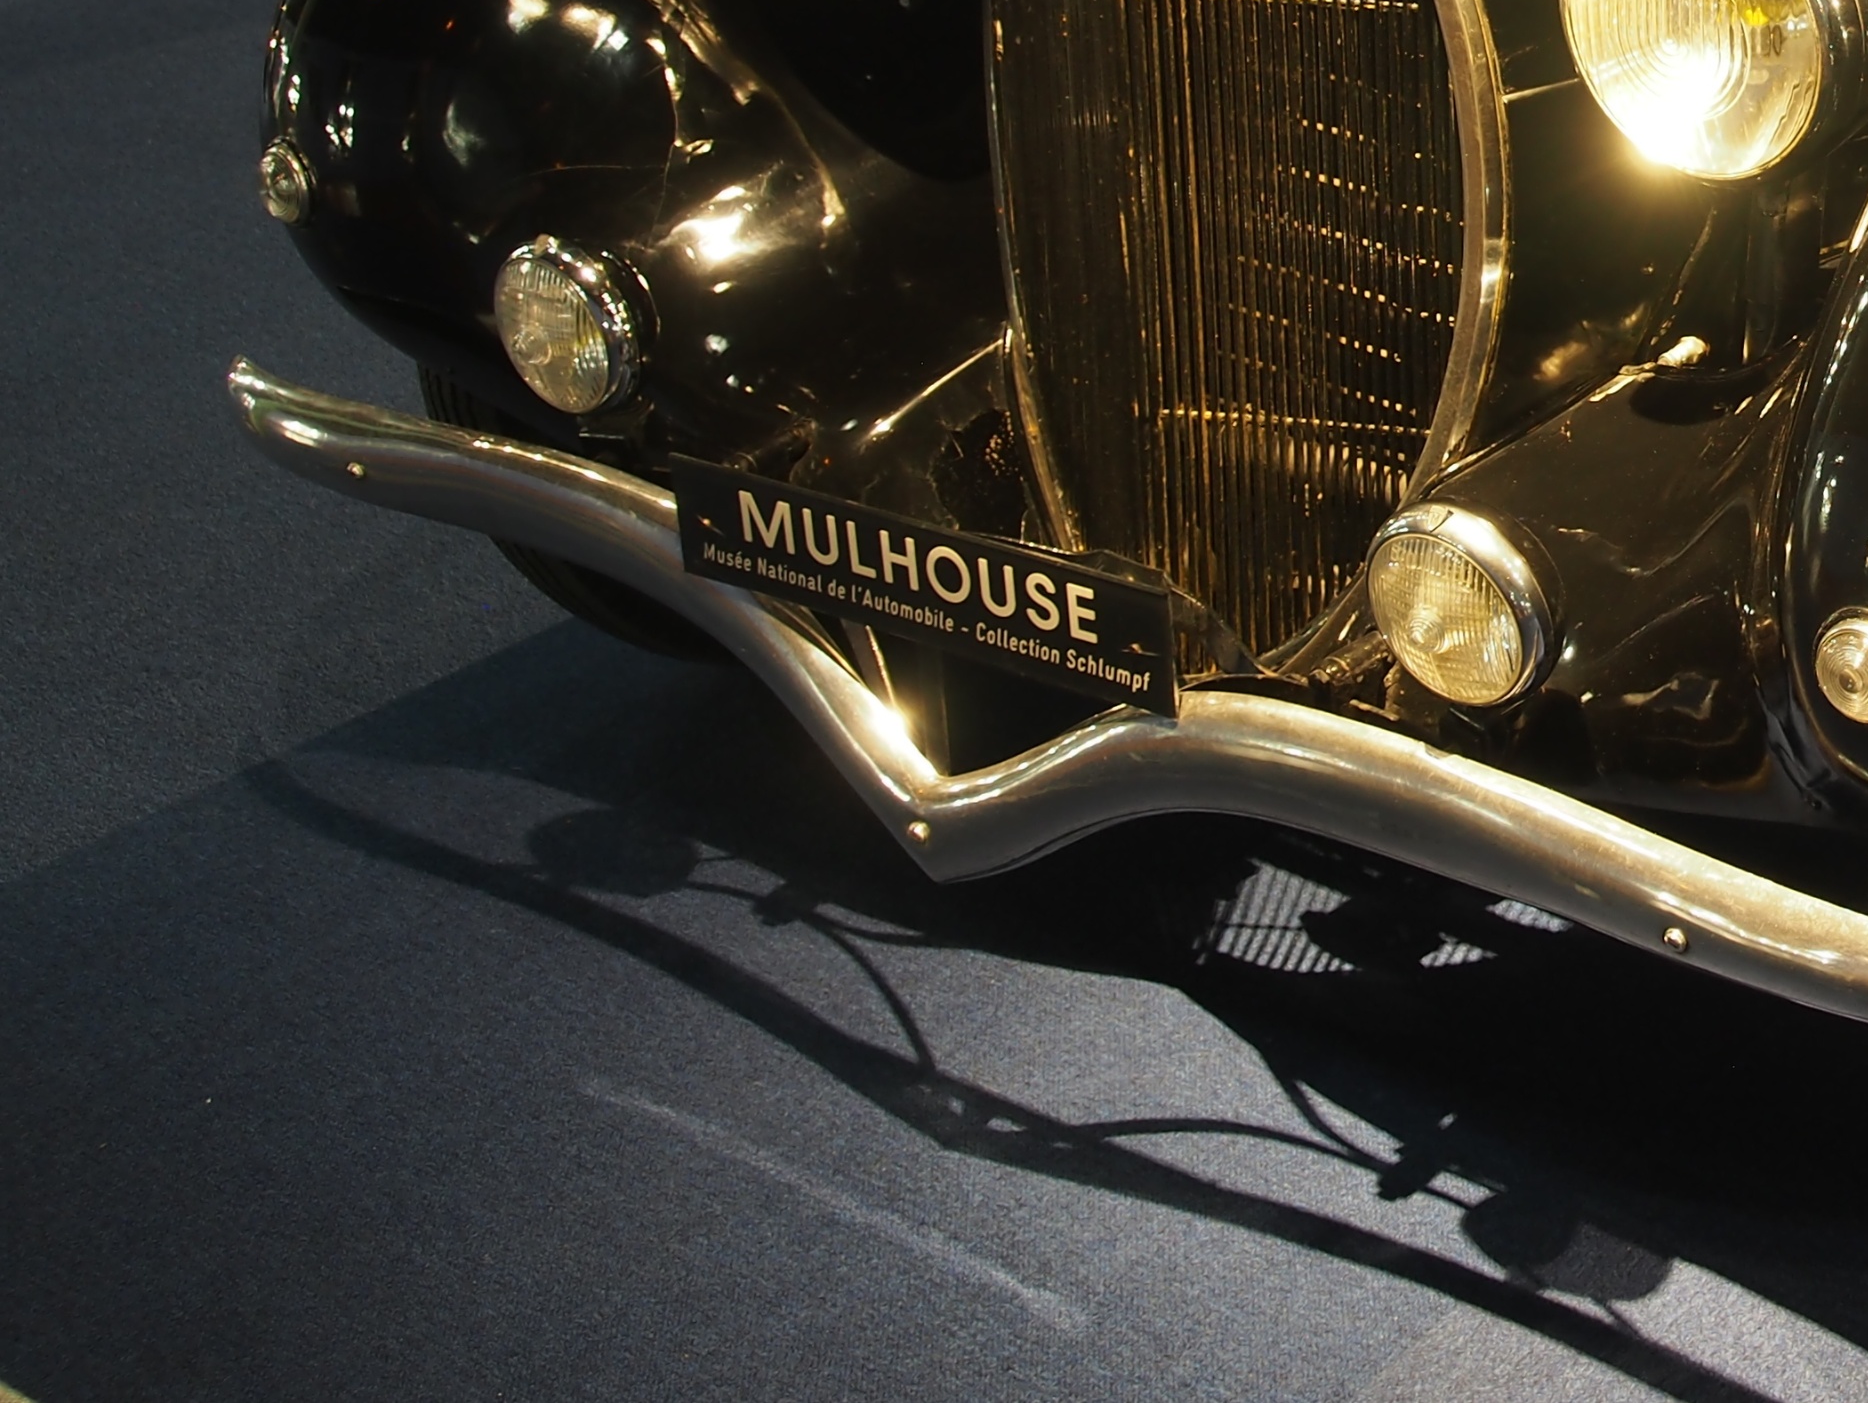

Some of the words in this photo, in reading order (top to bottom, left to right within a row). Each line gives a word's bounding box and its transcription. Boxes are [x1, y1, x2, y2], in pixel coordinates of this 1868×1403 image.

[703, 542, 752, 572] Musée
[757, 557, 823, 594] National
[827, 579, 847, 600] de
[851, 584, 955, 633] l'Automobile
[975, 622, 1061, 665] Collection
[1065, 649, 1151, 693] Schlumpf
[738, 489, 1099, 645] MULHOUSE
